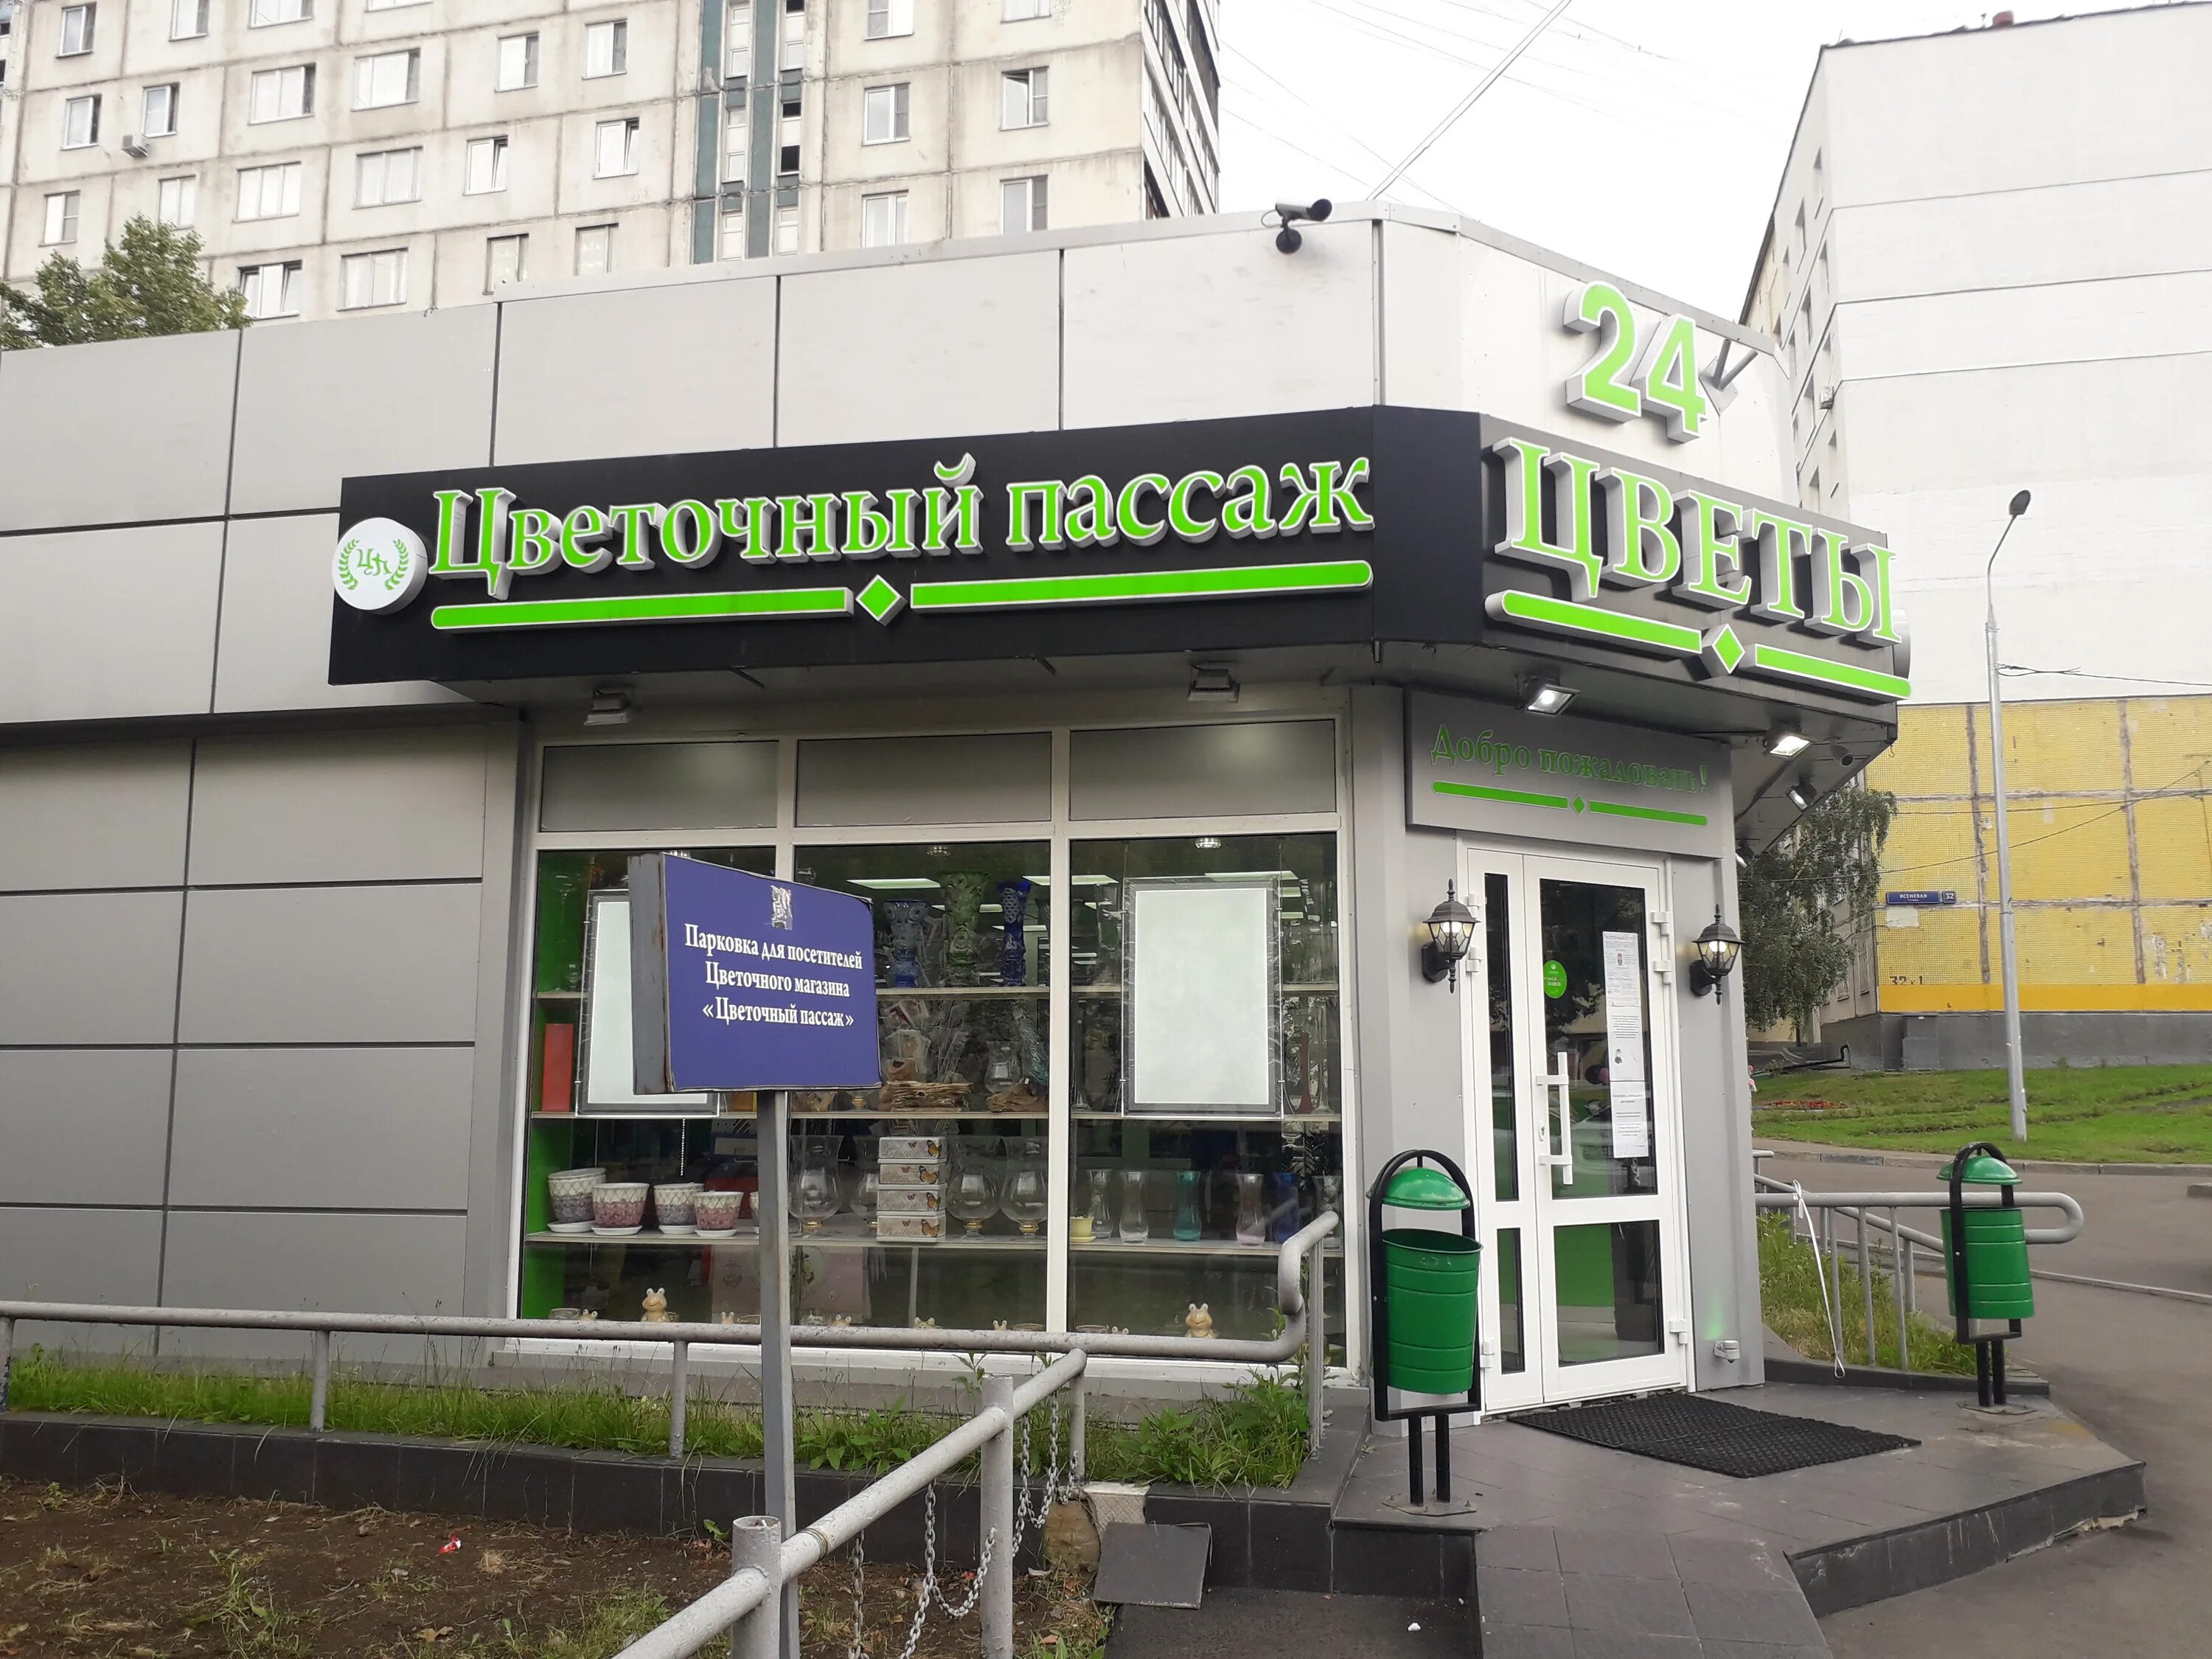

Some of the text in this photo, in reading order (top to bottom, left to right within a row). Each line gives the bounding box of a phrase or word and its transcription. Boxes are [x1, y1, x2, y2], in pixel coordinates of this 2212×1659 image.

[1563, 280, 1707, 442] 24
[428, 453, 1374, 600] Цветочный пассаж
[1494, 437, 1902, 647] ЦВЕТЫ
[1430, 724, 1709, 794] Добро пожаловать!
[684, 923, 863, 970] Парковка для посетителей
[705, 961, 850, 998] Цветочного магазина
[703, 997, 855, 1027] «Цветочный пассаж»
